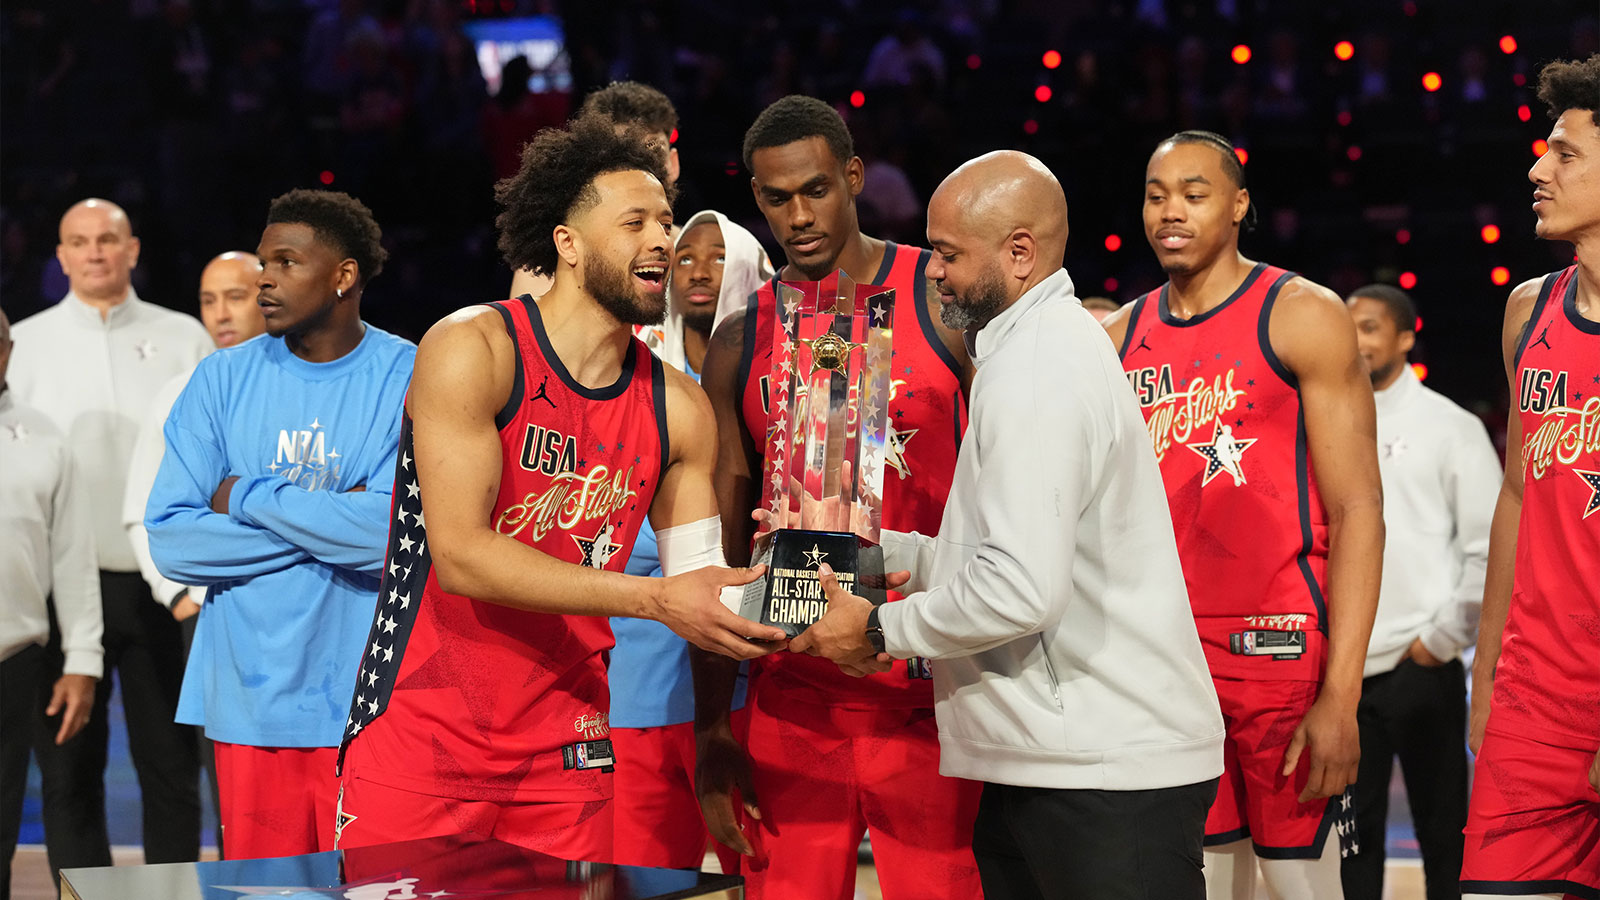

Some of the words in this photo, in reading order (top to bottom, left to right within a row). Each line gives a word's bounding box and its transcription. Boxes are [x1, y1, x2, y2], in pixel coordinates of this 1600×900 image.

[1520, 368, 1568, 417] USA
[277, 429, 325, 466] NBA
[520, 423, 577, 482] USA
[1521, 419, 1564, 481] All
[496, 484, 571, 542] All
[551, 464, 638, 530] Stars
[772, 578, 821, 599] ALL-STAR
[773, 568, 796, 578] NATIONAL
[796, 569, 820, 580] BASKETBA
